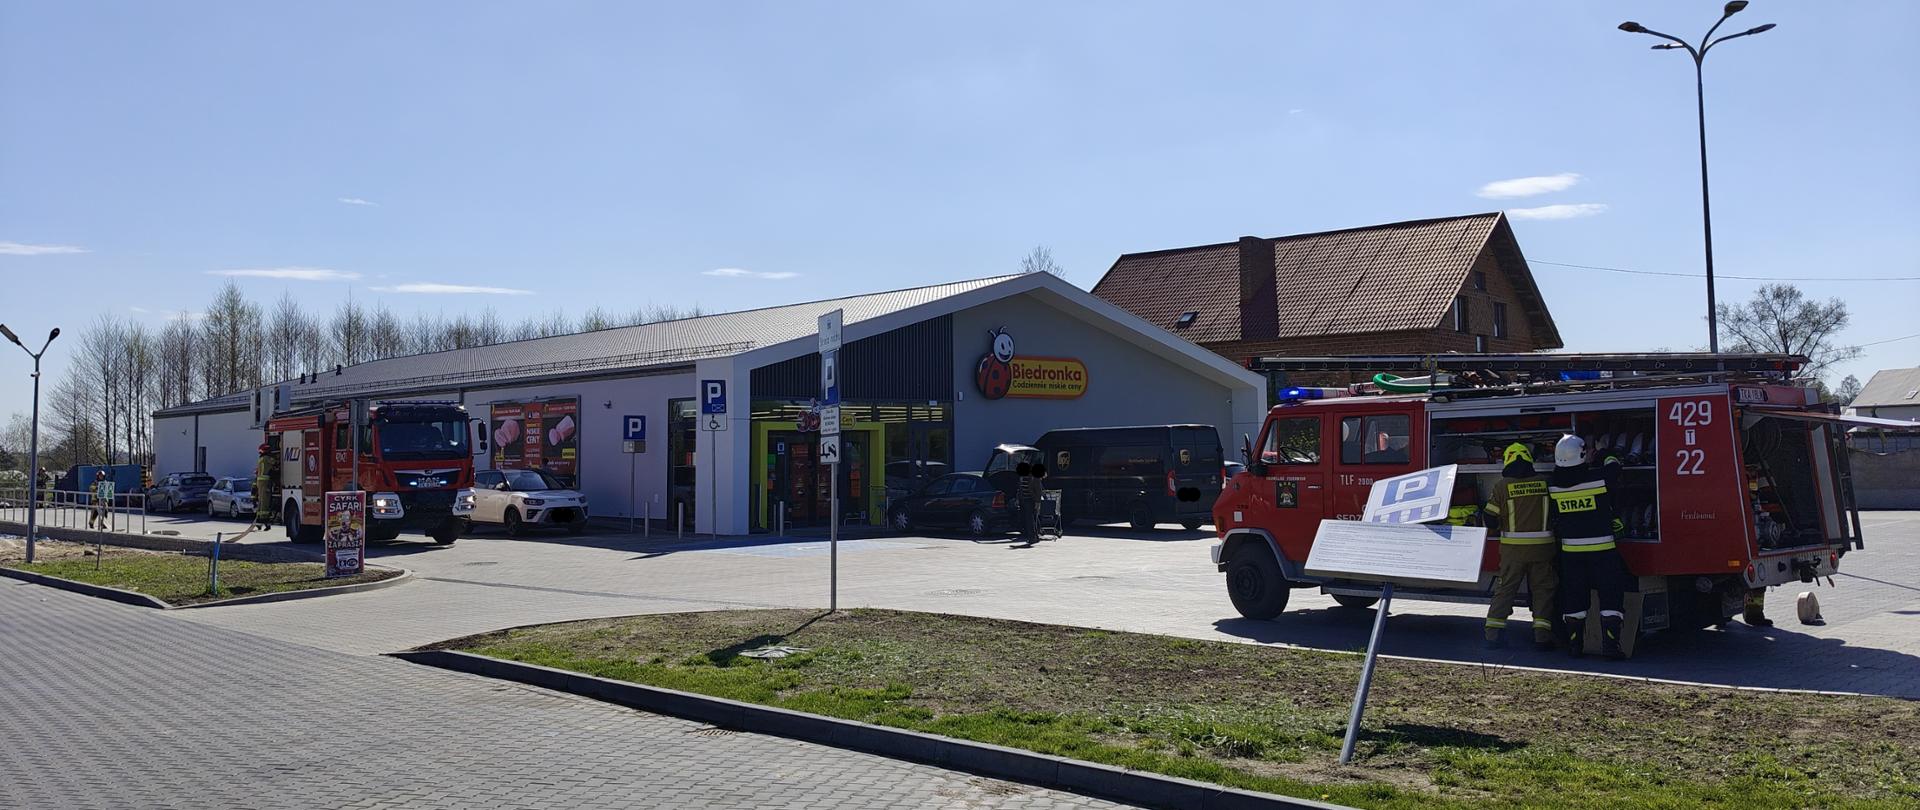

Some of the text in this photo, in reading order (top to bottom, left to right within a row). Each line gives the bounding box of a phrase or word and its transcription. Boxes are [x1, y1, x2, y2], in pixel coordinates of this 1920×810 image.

[825, 357, 835, 400] P
[1012, 363, 1082, 381] Biedronka
[707, 382, 722, 404] P
[1012, 380, 1046, 389] Codziennie
[1048, 381, 1067, 389] niskie
[1668, 400, 1712, 427] 429
[628, 418, 642, 438] P
[1676, 448, 1705, 475] 22
[1340, 474, 1355, 486] TLF
[1395, 475, 1429, 501] P
[329, 502, 362, 513] SAFARI
